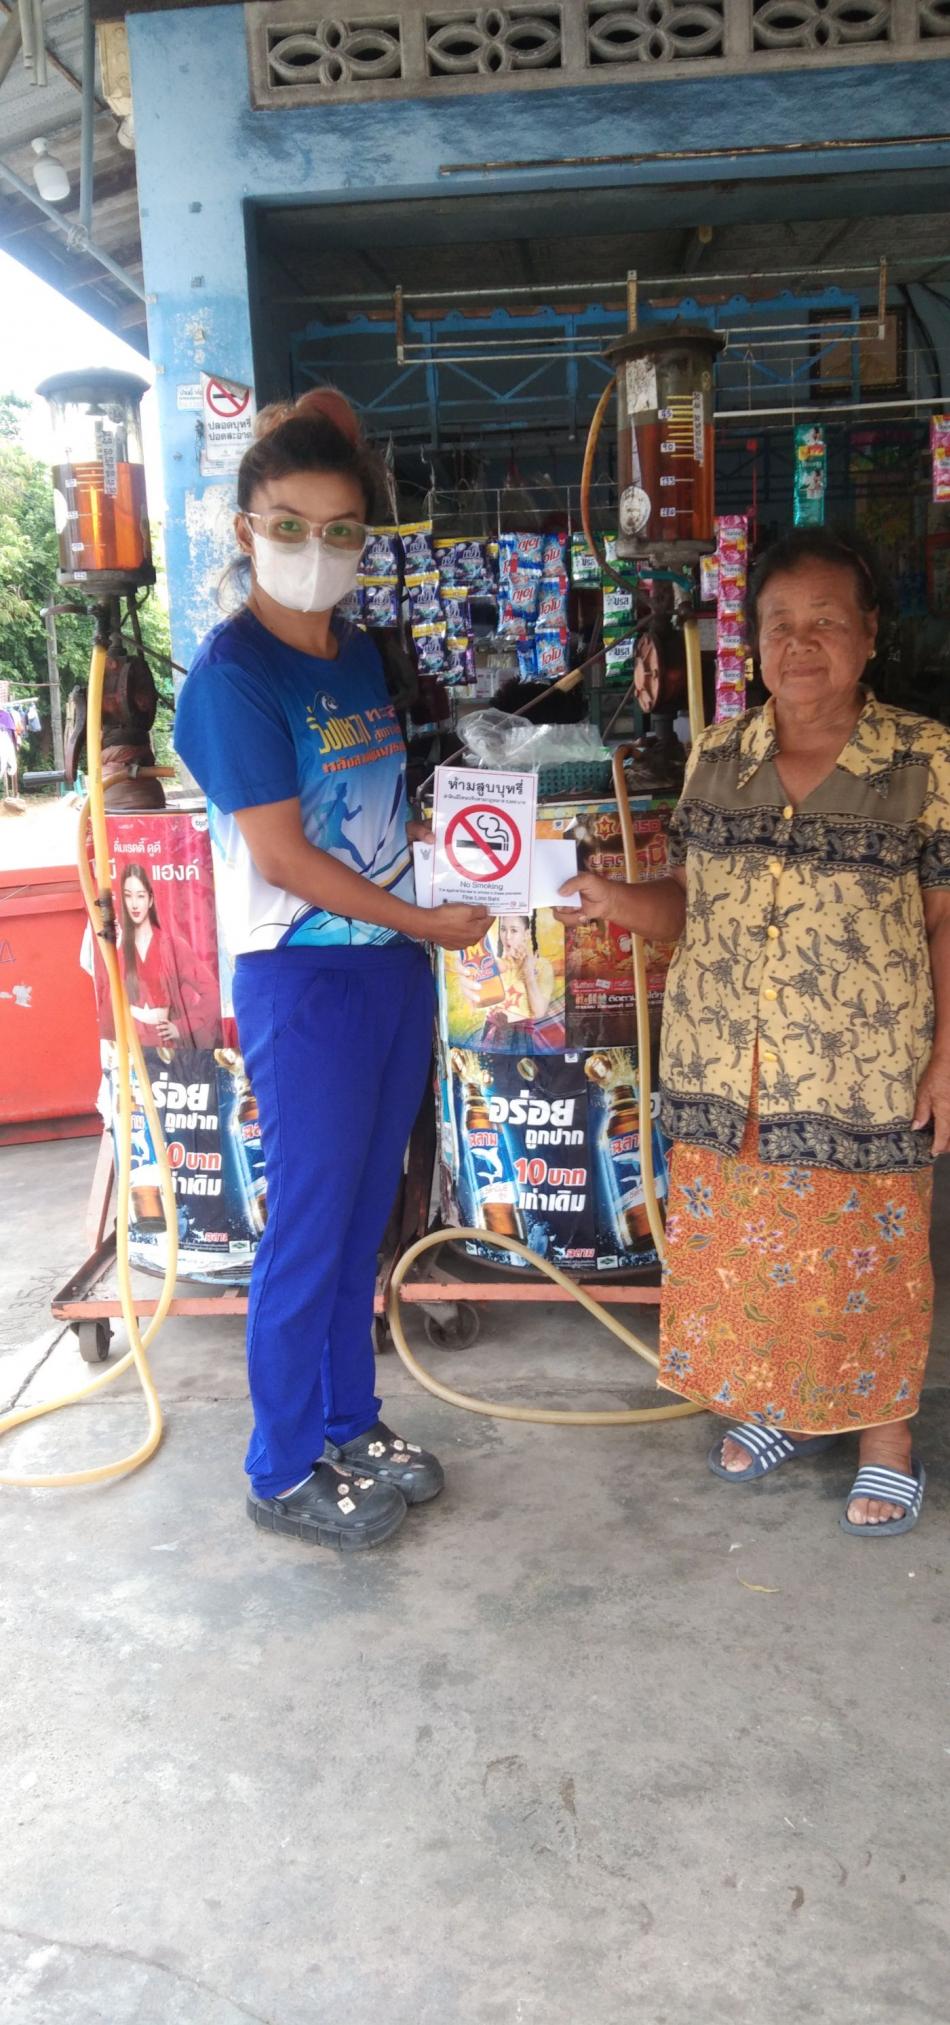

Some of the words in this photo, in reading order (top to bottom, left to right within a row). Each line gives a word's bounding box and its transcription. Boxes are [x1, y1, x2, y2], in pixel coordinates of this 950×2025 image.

[448, 777, 524, 798] ห้ามสูบบุหรี่
[151, 858, 200, 881] แฮงค์
[472, 881, 504, 891] Smoking
[151, 1071, 210, 1111] ร่อย
[488, 1090, 576, 1127] อร่อย
[165, 1112, 218, 1133] ถูกปาก
[525, 1129, 584, 1149] ถูกปาก
[610, 1133, 640, 1155] ฉลา
[165, 1141, 185, 1169] 0
[186, 1152, 222, 1171] บาท
[172, 1170, 222, 1196] ่าเดิม
[513, 1158, 548, 1186] 10
[548, 1168, 587, 1187] บาท
[517, 1188, 587, 1212] เท่าเดิม
